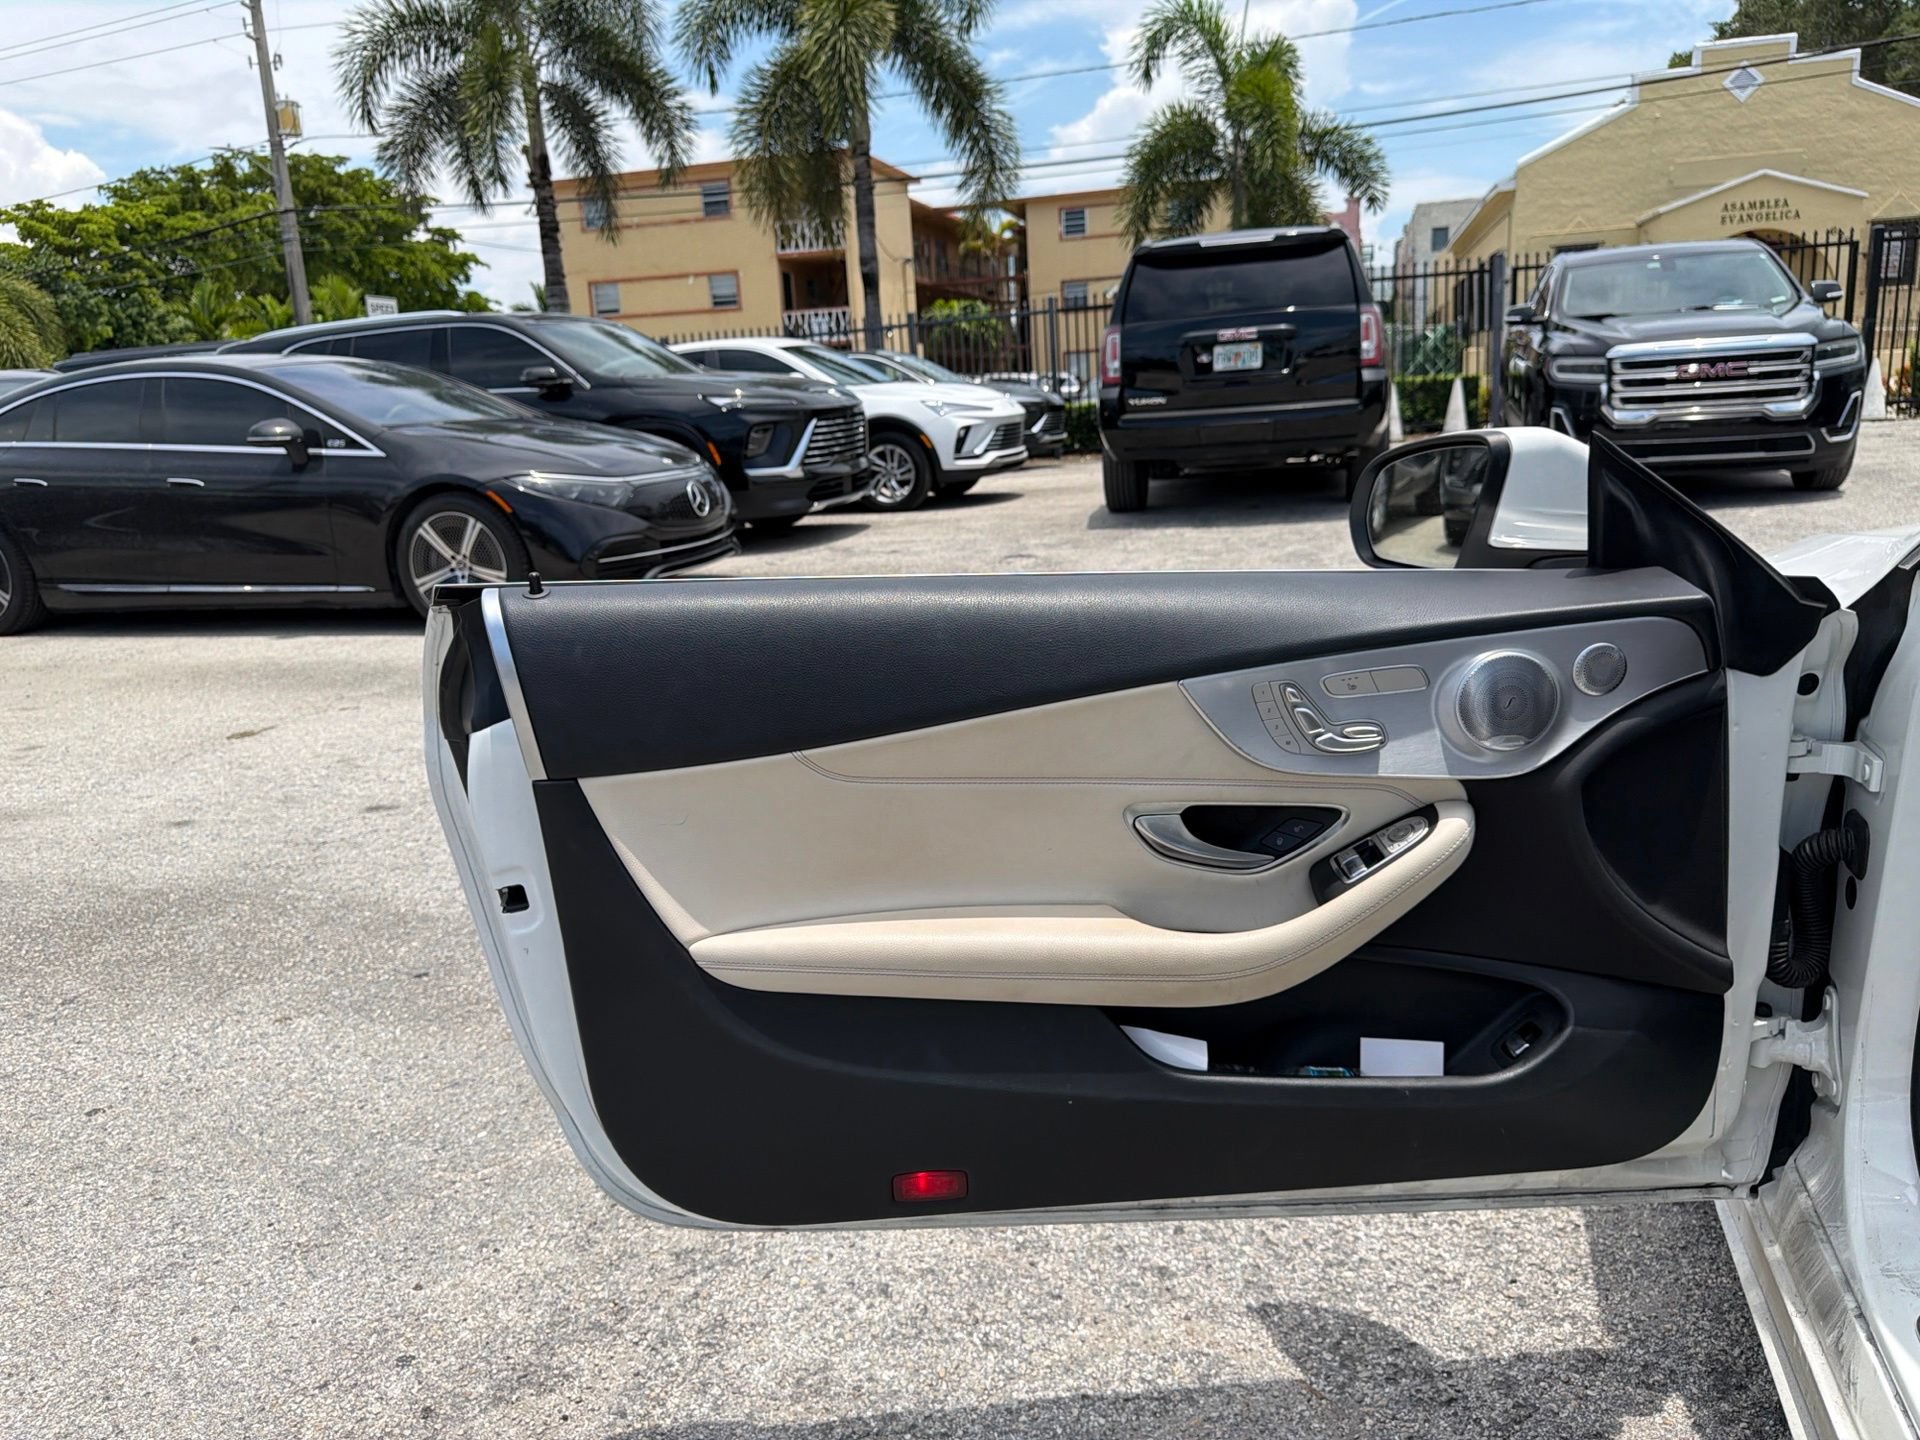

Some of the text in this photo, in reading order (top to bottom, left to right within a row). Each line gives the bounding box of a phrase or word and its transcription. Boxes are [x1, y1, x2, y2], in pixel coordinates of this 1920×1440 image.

[1722, 197, 1789, 212] ASAMBLEA
[1720, 209, 1800, 225] EVANGELICA
[1677, 361, 1748, 380] GMC
